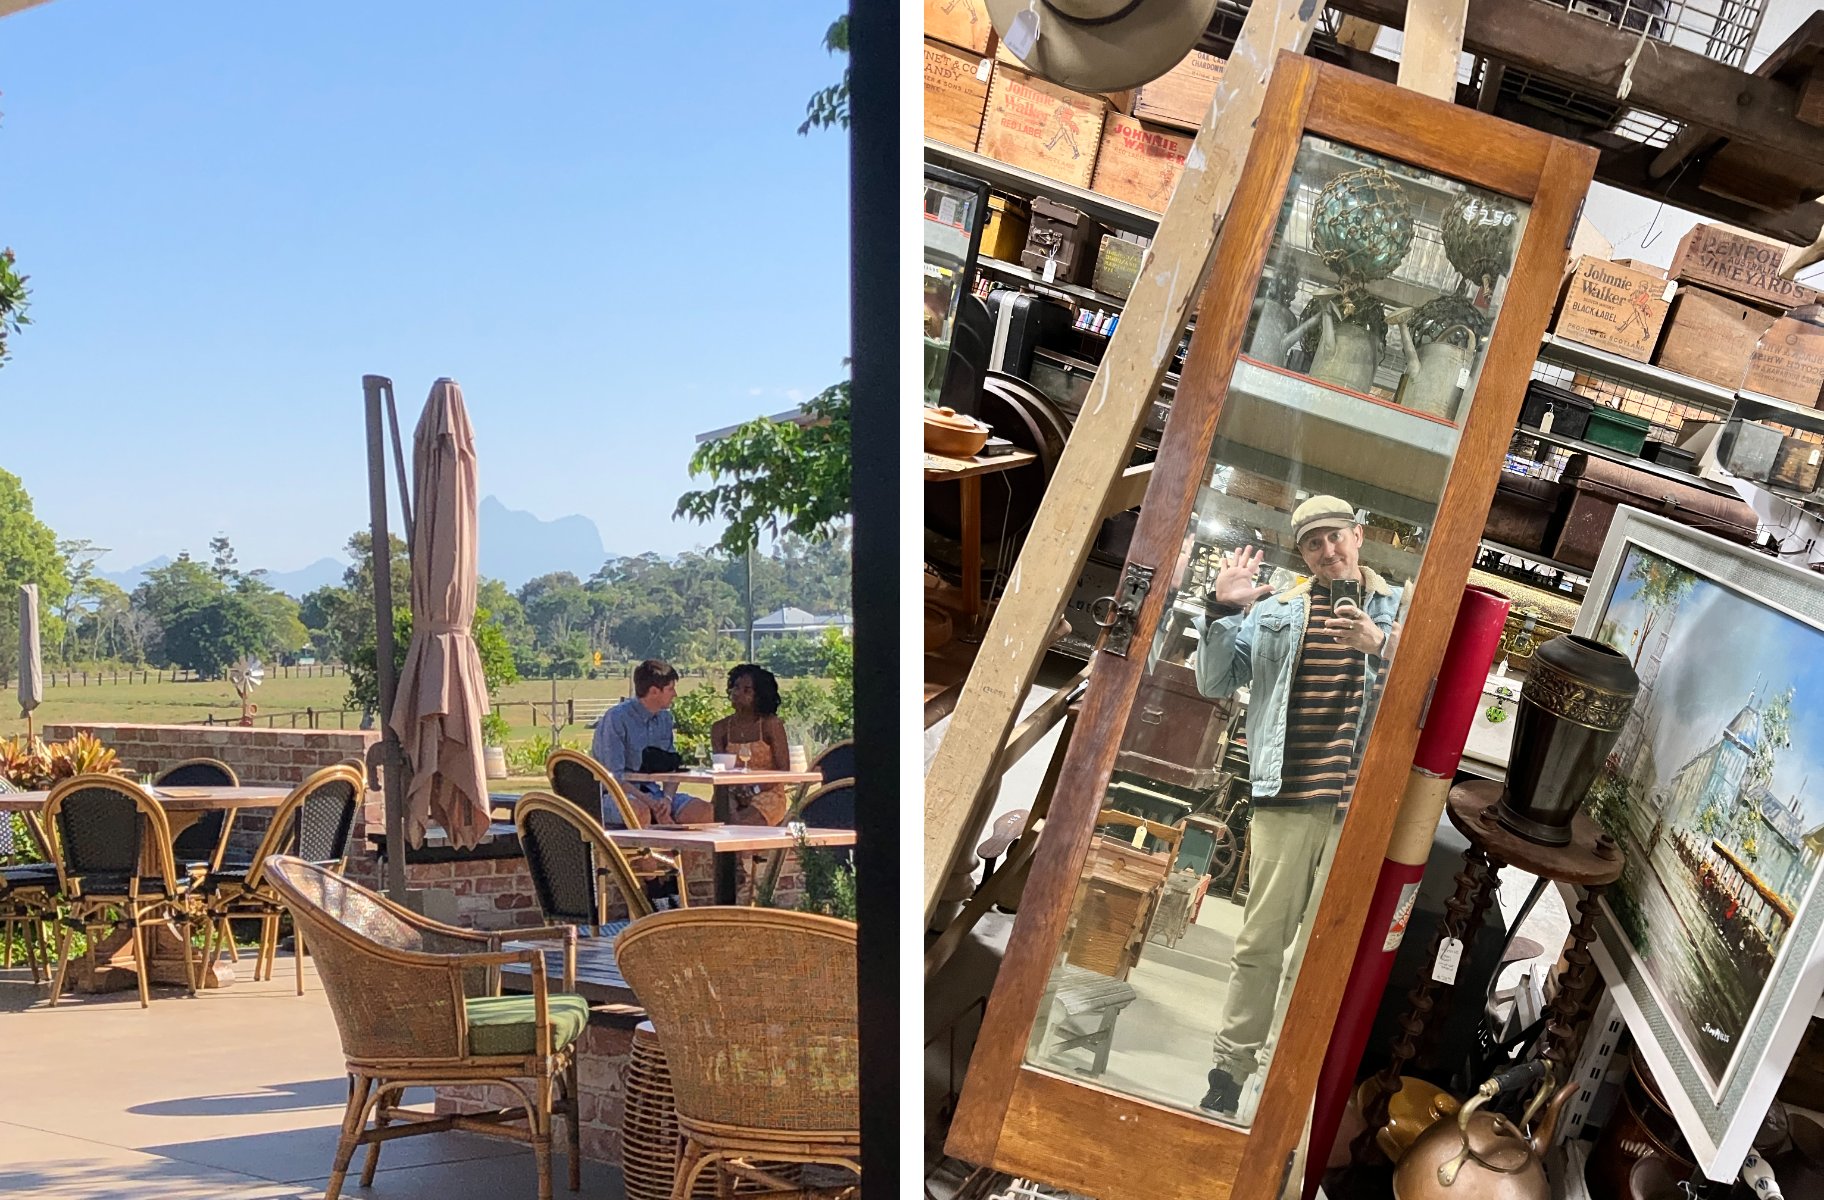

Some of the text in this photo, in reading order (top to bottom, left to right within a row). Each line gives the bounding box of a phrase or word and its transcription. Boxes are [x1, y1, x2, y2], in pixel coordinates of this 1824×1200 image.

[1005, 80, 1055, 106] Johnnie
[1004, 94, 1051, 122] Walker
[1001, 117, 1017, 129] RED
[1018, 124, 1042, 139] LABEL
[1114, 123, 1178, 152] JOHNNIE
[1584, 264, 1632, 291] Johnnie
[1701, 256, 1804, 298] VINEYARDS
[1727, 257, 1776, 276] AUSTRALIA
[1582, 280, 1627, 306] Walker
[1572, 302, 1617, 324] BLACK LABEL
[1609, 335, 1645, 351] SCOTLAND
